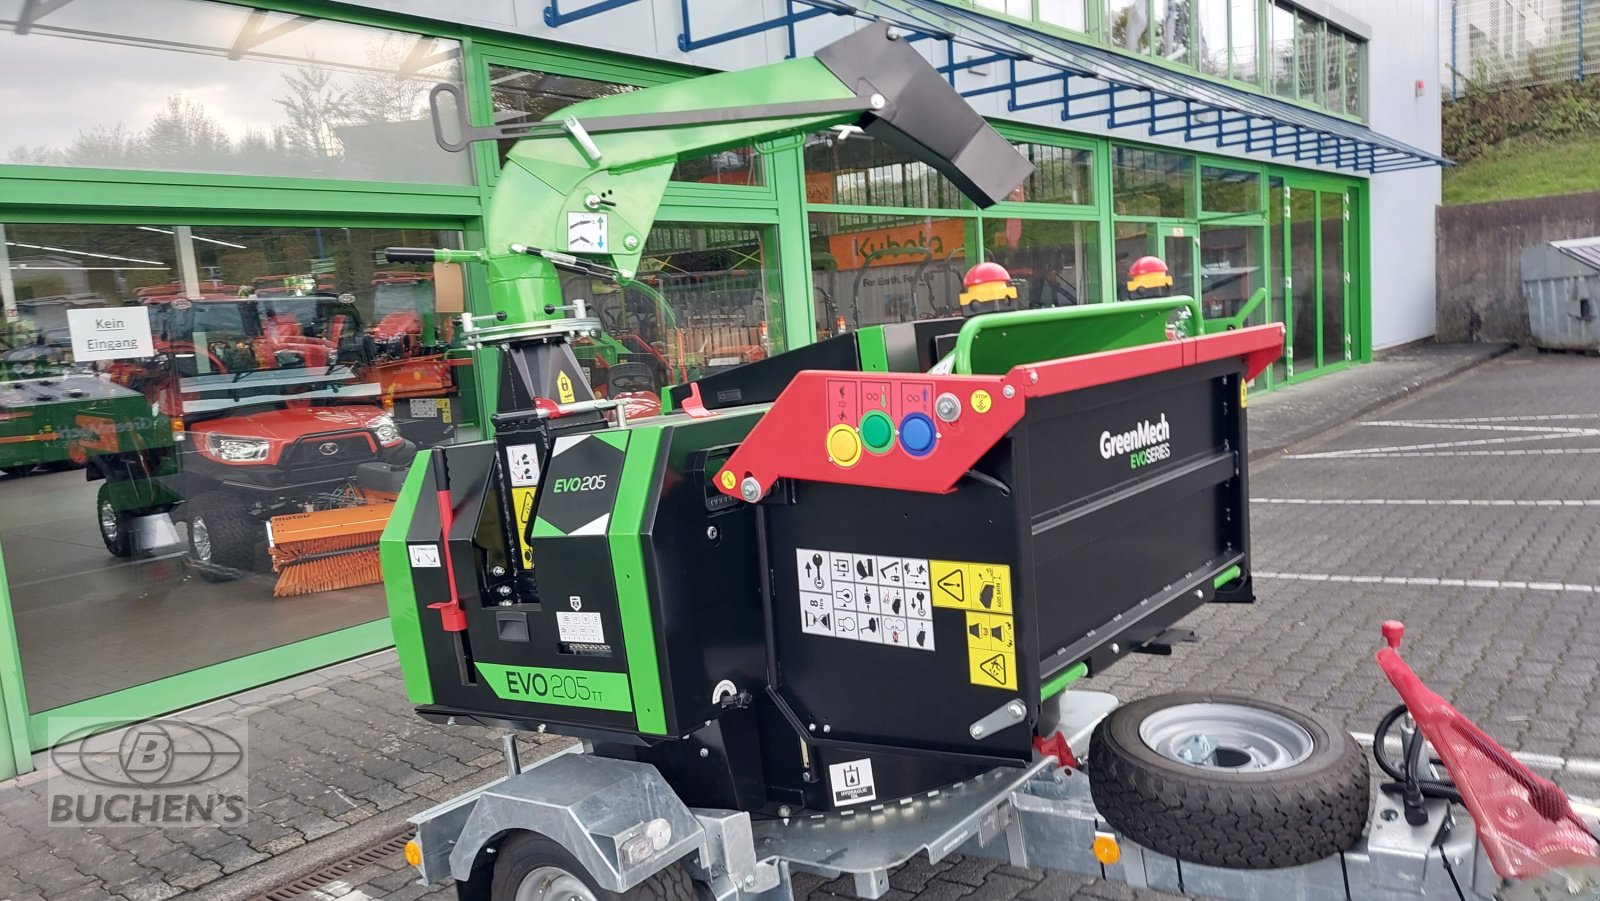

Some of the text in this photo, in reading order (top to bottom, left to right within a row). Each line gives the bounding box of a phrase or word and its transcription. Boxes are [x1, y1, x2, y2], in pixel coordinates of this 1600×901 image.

[853, 231, 944, 260] Kubota
[95, 318, 125, 329] Kein
[87, 339, 139, 351] Eingang
[1100, 412, 1169, 460] GreenMech
[809, 599, 819, 608] 8
